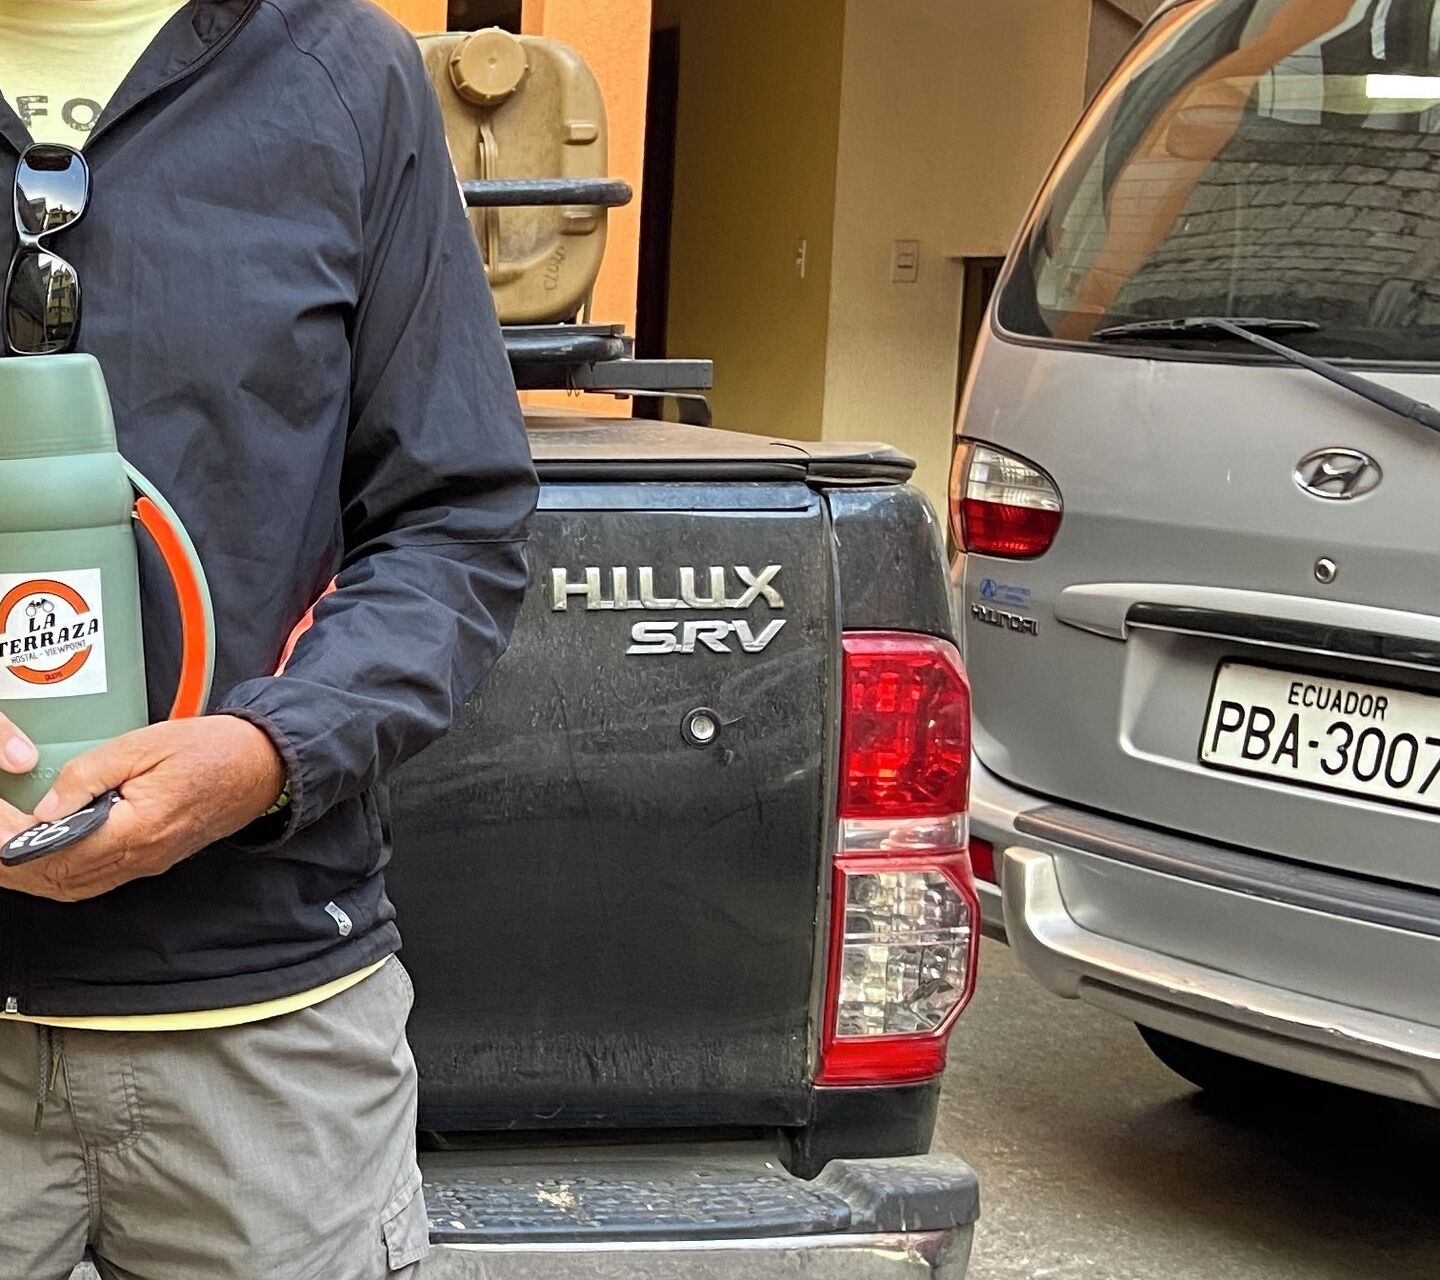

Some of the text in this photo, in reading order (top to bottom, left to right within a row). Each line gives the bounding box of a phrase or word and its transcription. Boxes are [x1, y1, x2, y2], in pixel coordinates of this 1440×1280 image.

[551, 564, 785, 612] HILUX
[28, 613, 56, 634] LA
[625, 619, 787, 655] SRV
[11, 639, 86, 664] HOSTAL VIEWPOINT
[1287, 681, 1389, 721] ECUADOR
[1211, 699, 1440, 795] PBA-3007
